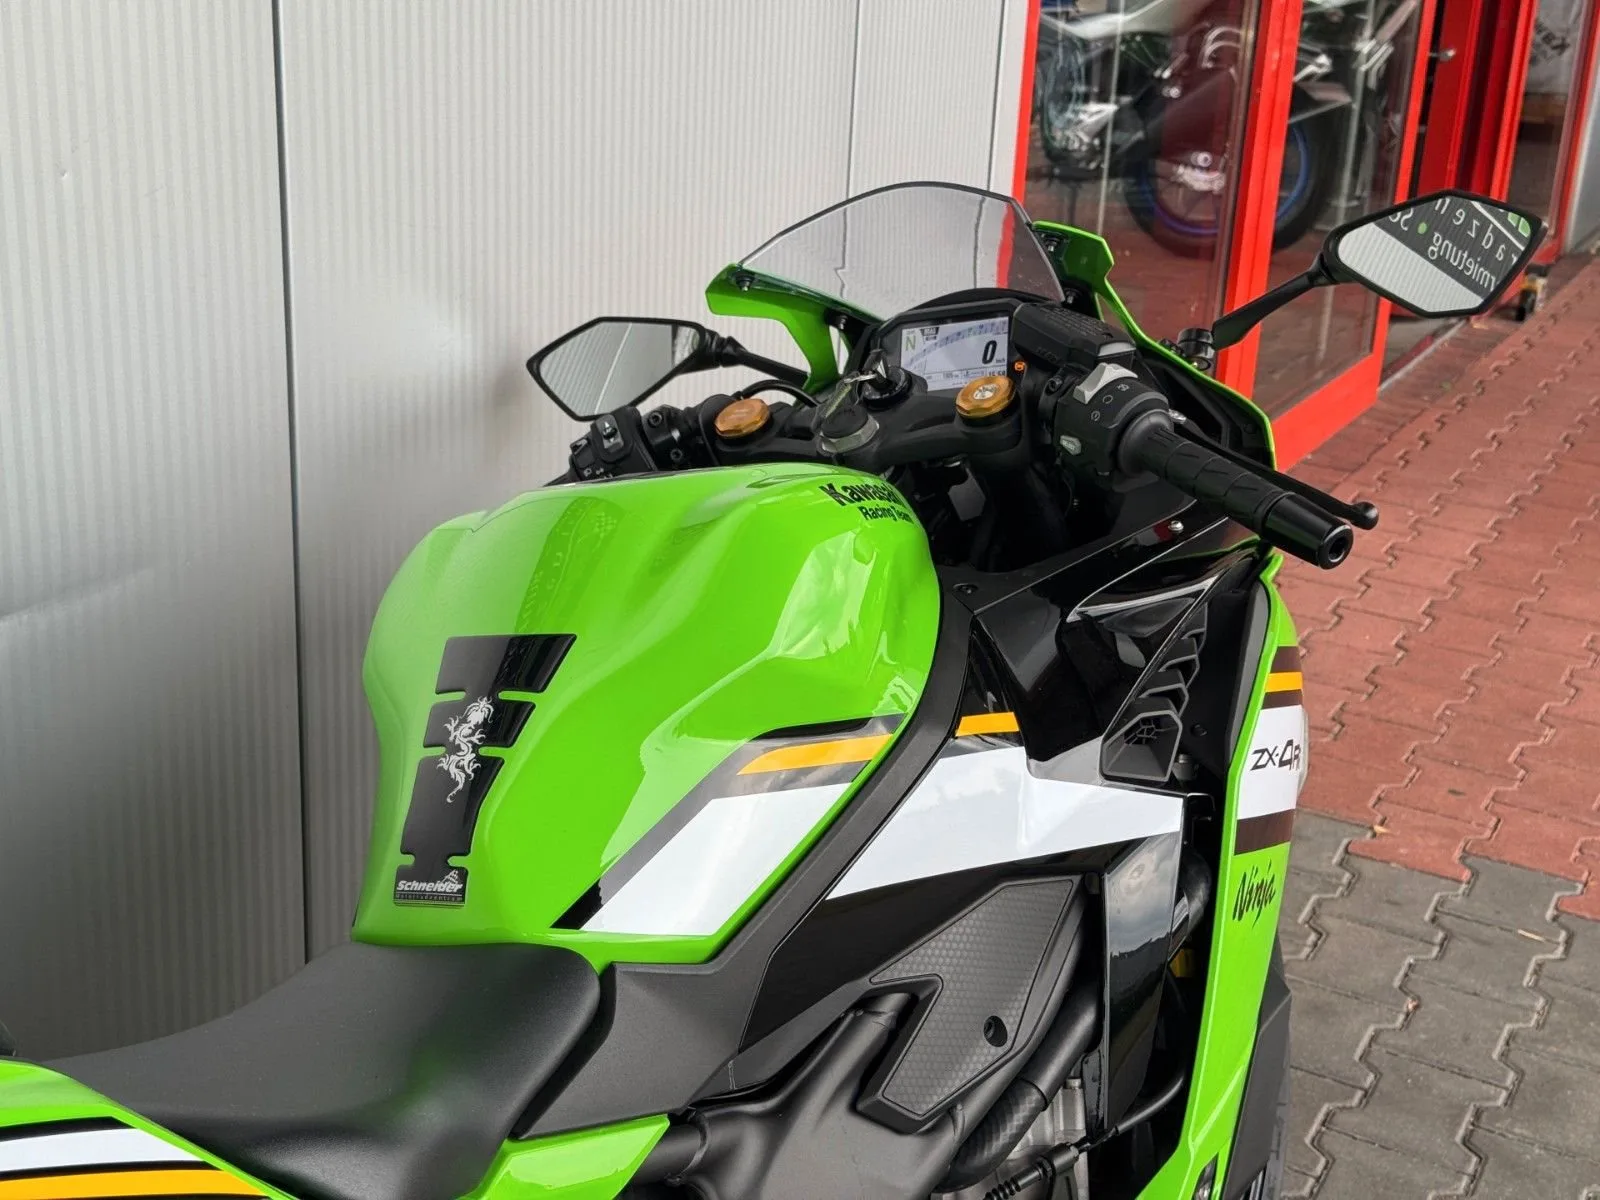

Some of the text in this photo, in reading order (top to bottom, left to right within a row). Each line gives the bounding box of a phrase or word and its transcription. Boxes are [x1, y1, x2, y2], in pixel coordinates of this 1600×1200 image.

[905, 335, 916, 351] N
[982, 340, 998, 365] 0
[858, 504, 898, 522] Racing
[396, 880, 463, 892] Schneider
[1232, 858, 1276, 929] Ninja
